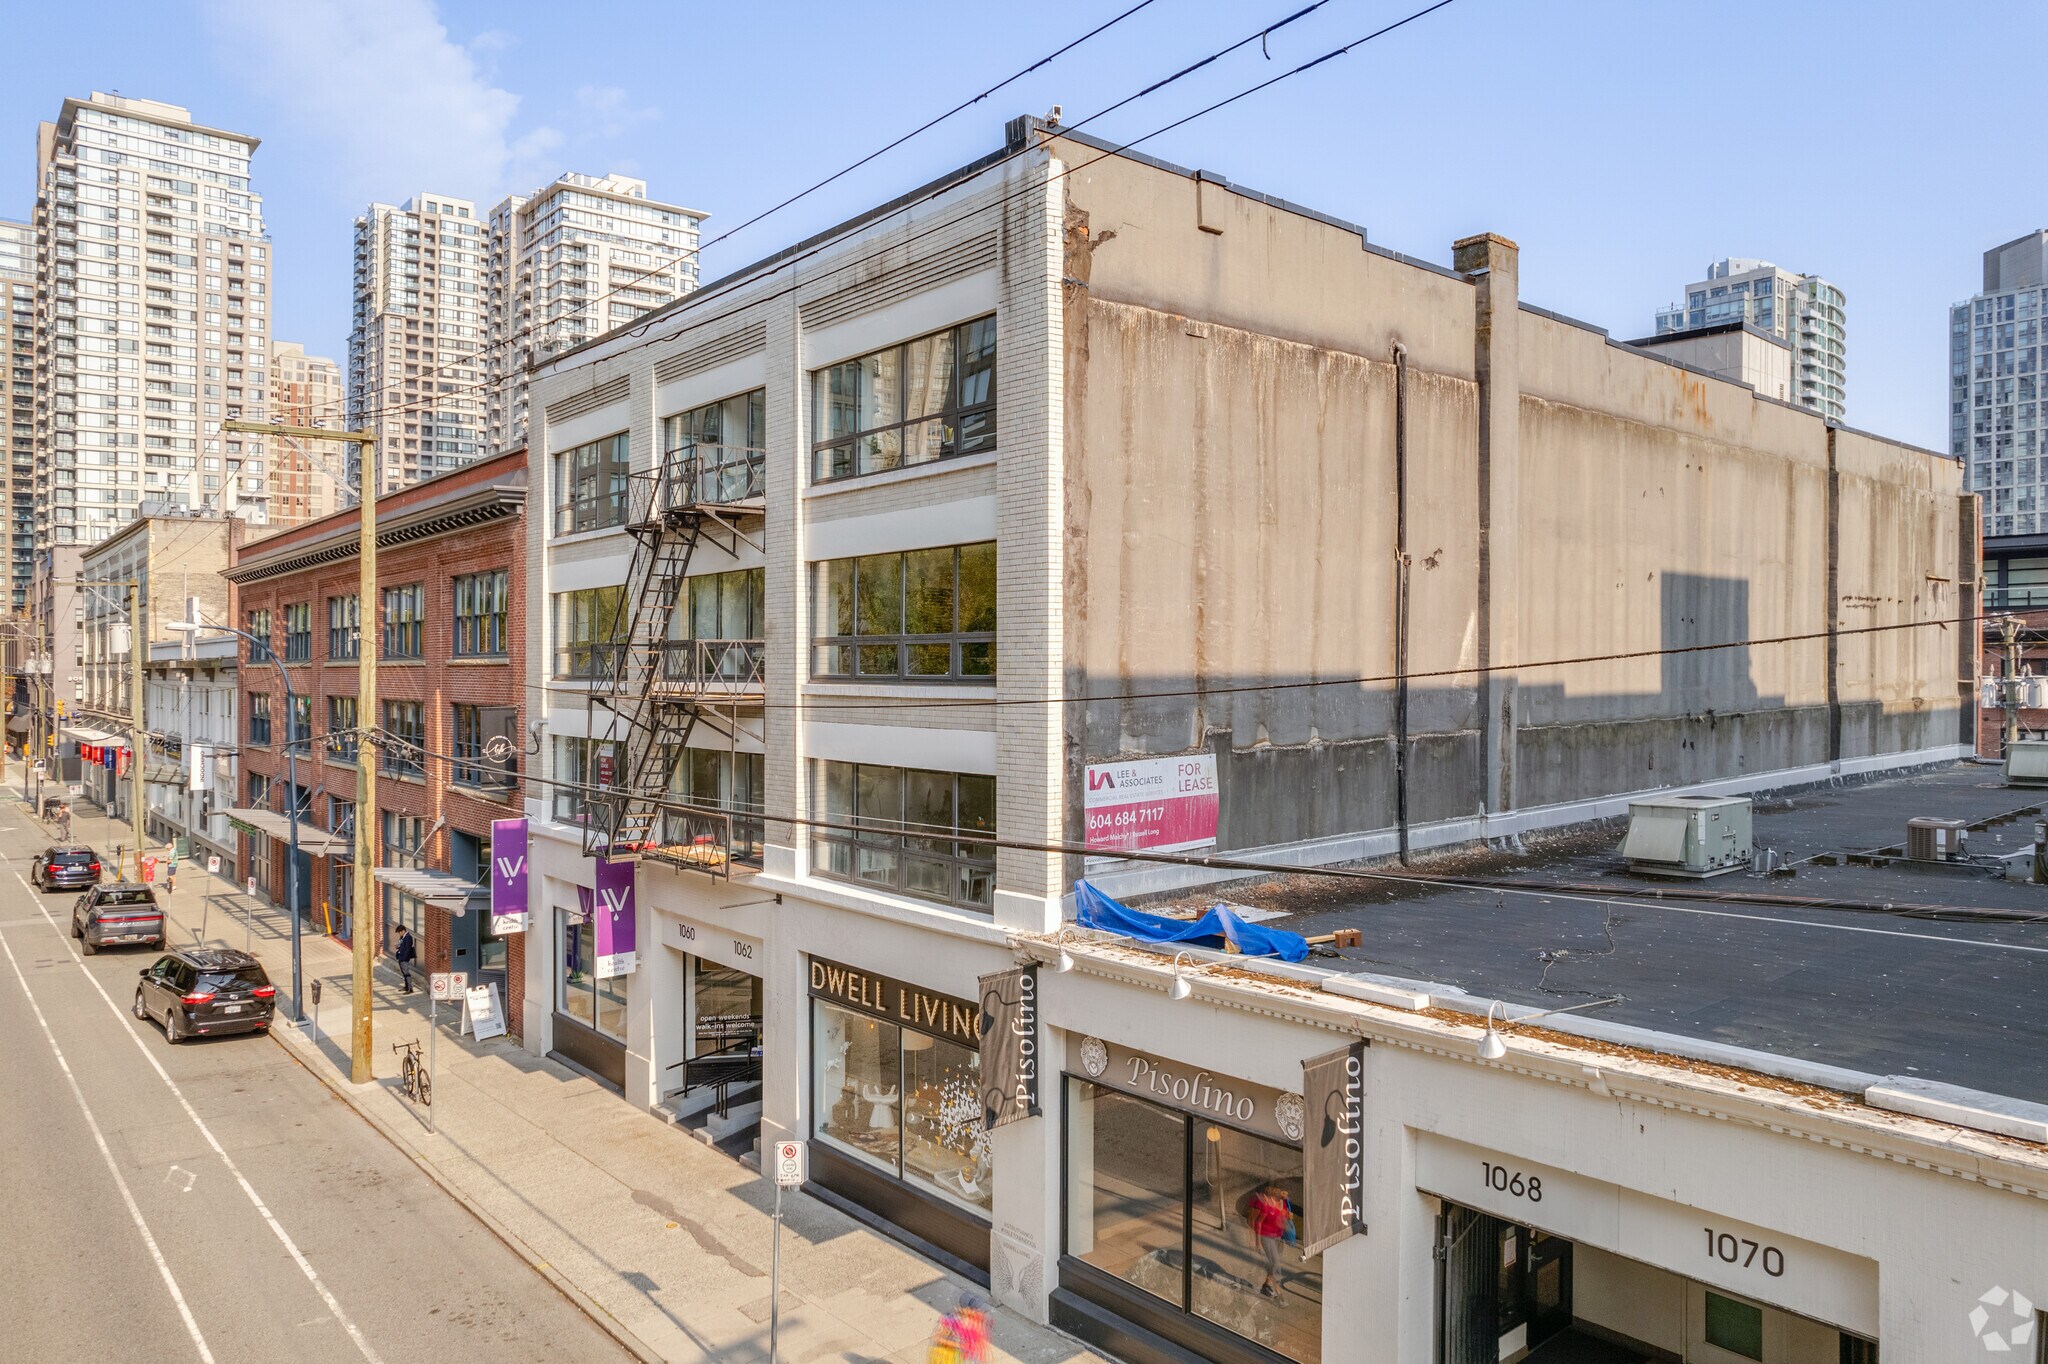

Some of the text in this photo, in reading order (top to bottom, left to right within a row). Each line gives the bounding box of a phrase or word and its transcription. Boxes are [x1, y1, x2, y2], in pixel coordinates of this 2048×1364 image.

[1117, 768, 1137, 779] LEE &
[1178, 763, 1201, 777] FOR
[1119, 775, 1163, 788] ASSOCIATES
[1178, 777, 1213, 792] LEASE
[1088, 793, 1118, 803] COMMERCIAL
[1089, 807, 1164, 829] 604 684 7117
[1089, 835, 1109, 844] Howard
[1147, 828, 1160, 837] Long
[679, 924, 695, 941] 1060
[734, 940, 752, 959] 1062
[811, 961, 887, 1013] DWELL
[700, 1015, 716, 1023] open
[726, 1021, 755, 1029] welcome
[1011, 973, 1035, 1109] Pisolino
[1126, 1055, 1256, 1121] Pisolino
[1336, 1055, 1362, 1228] Pisolino
[1481, 1160, 1543, 1203] 1068
[1703, 1226, 1785, 1278] 1070
